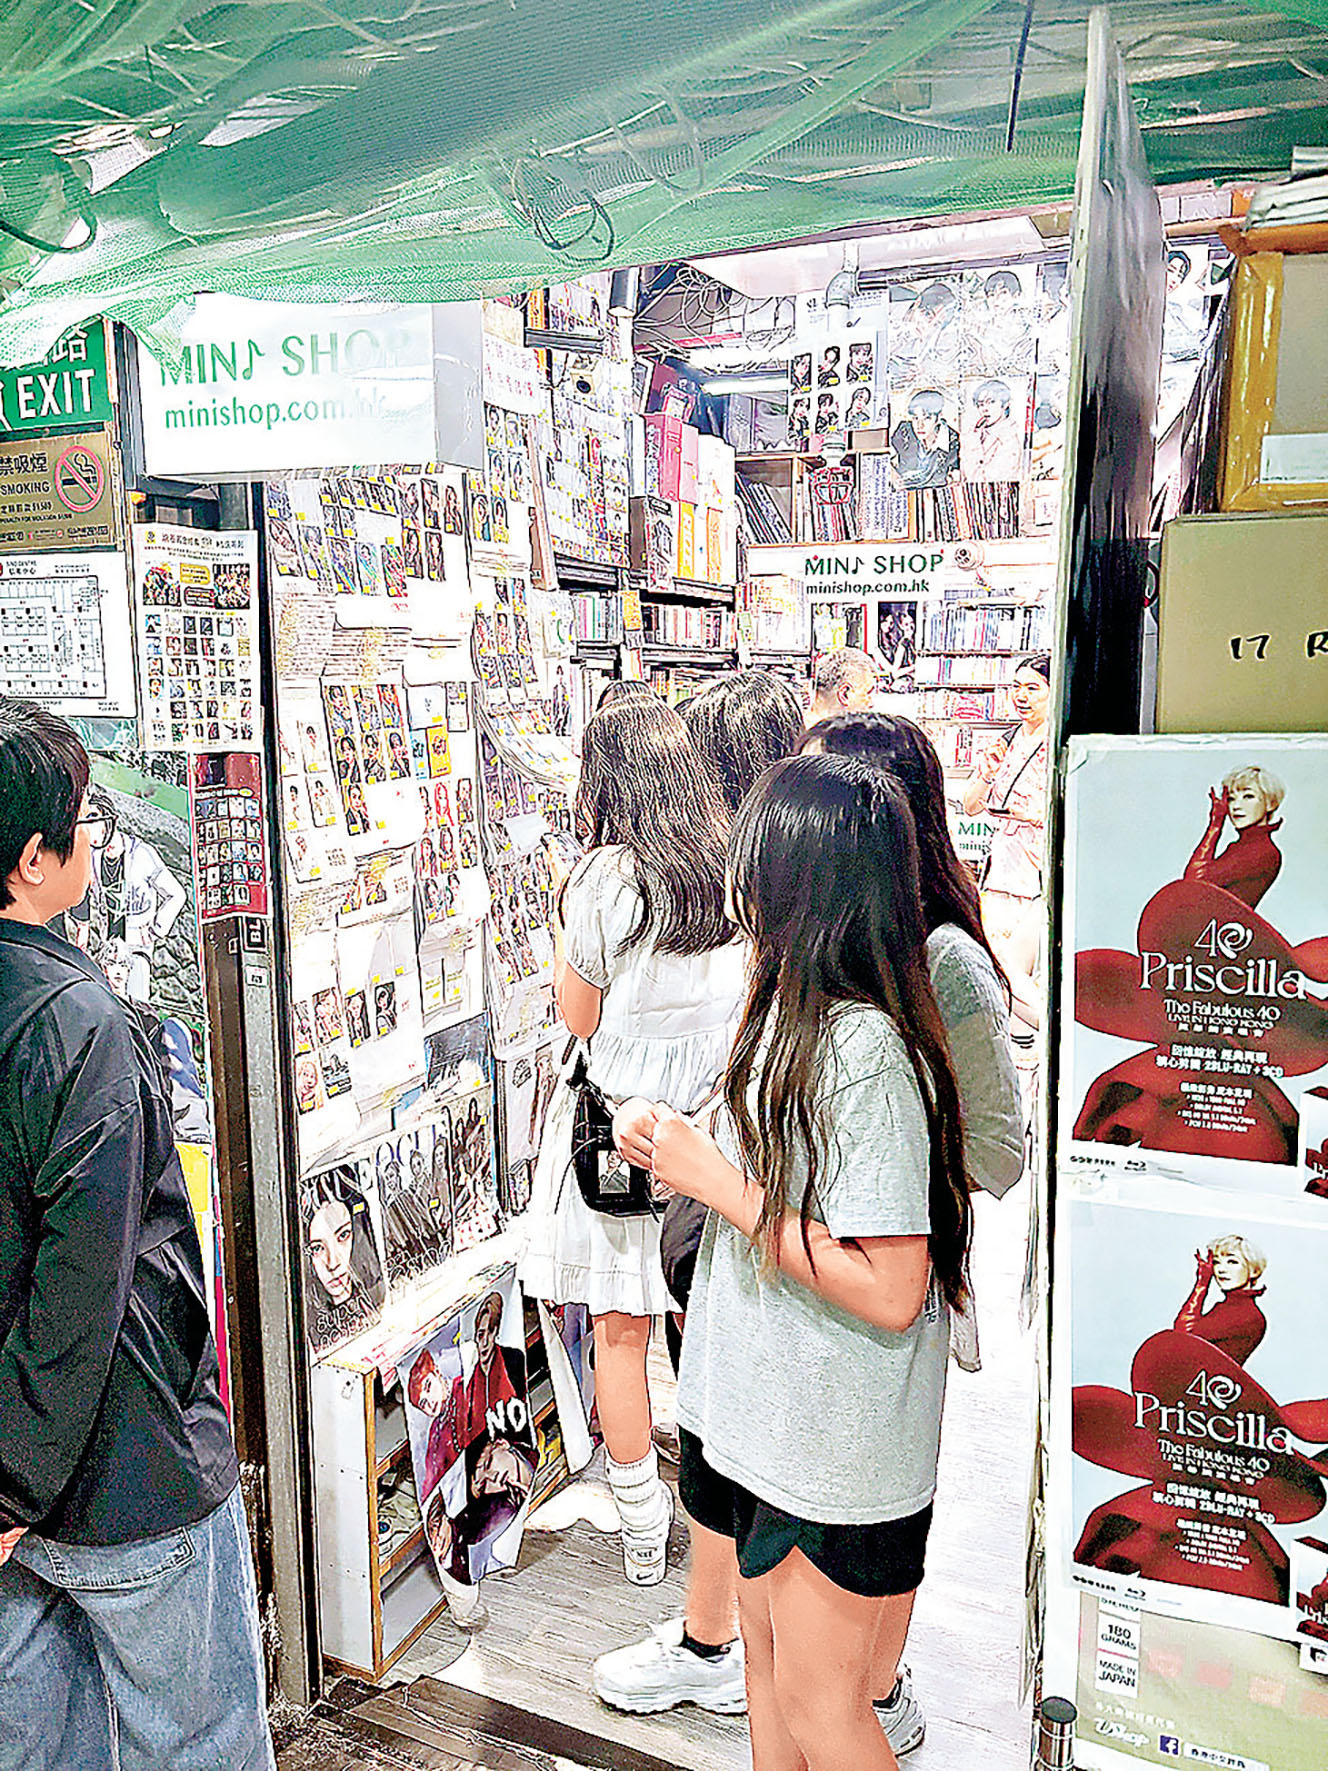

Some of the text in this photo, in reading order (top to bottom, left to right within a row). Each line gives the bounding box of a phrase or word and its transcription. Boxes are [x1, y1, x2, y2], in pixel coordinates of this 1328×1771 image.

[17, 369, 95, 420] EXIT
[0, 480, 50, 495] SMOKING
[873, 554, 944, 574] SHOP
[806, 579, 930, 596] minishop.com.hk
[1230, 634, 1270, 660] 17
[1139, 951, 1307, 1000] Priscilla
[1163, 999, 1281, 1021] The Fabulous 40
[1134, 1391, 1295, 1455] Priscilla
[1157, 1438, 1270, 1472] The Fabulous 40
[1098, 1670, 1136, 1688] JAPAN
